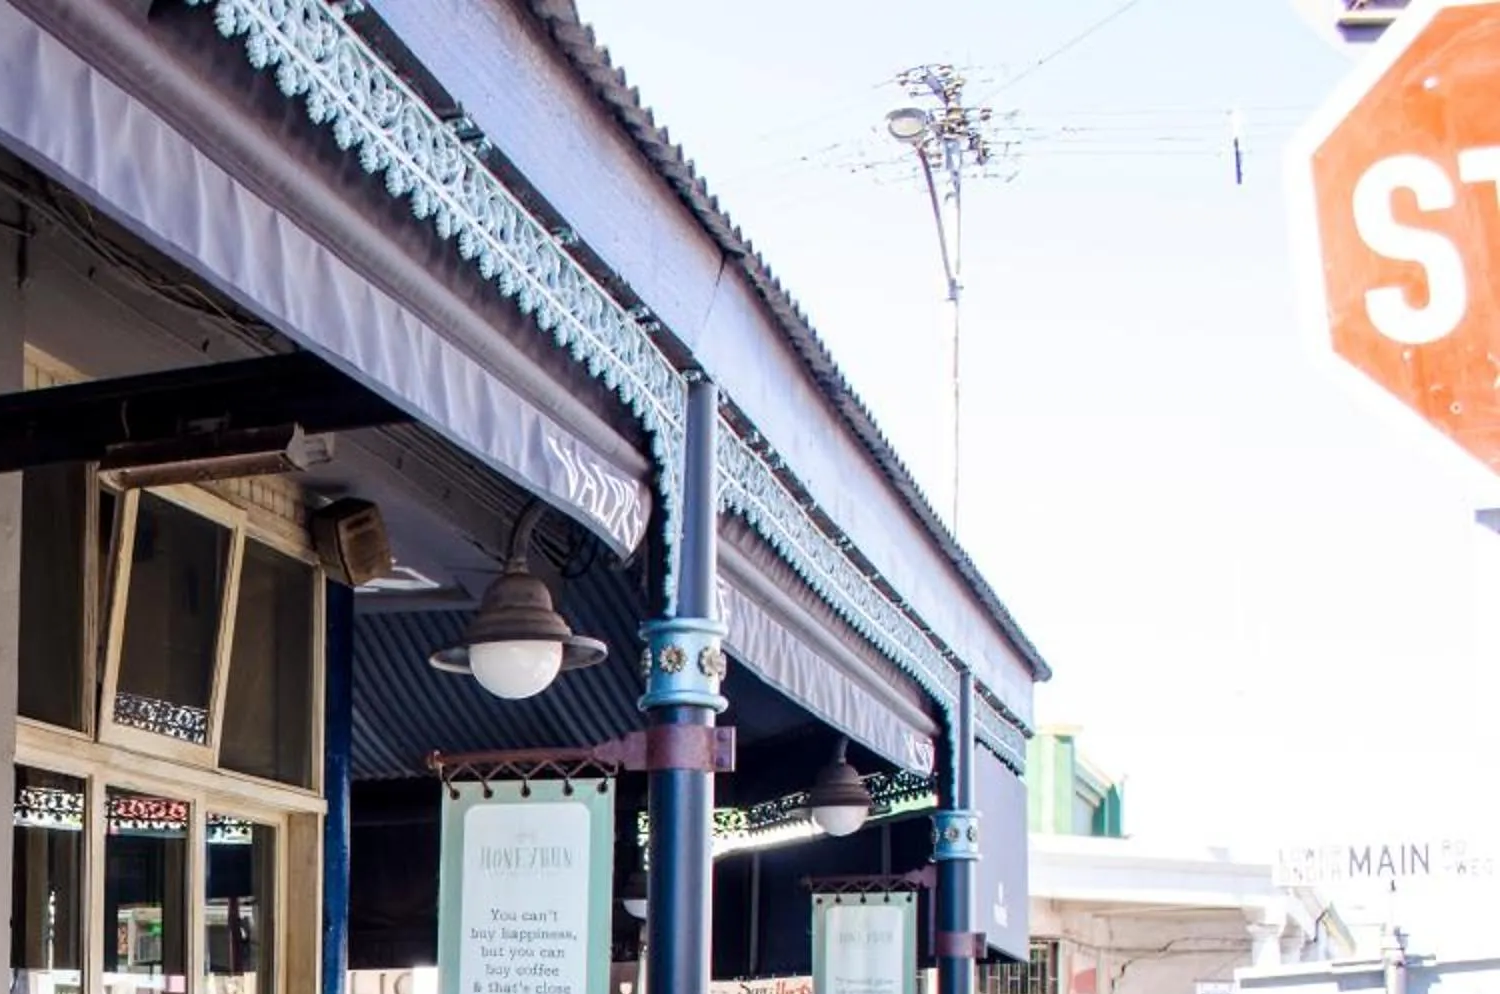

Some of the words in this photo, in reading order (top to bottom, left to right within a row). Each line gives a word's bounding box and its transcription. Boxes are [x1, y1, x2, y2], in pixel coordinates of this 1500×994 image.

[1347, 843, 1430, 879] MAIN
[491, 908, 517, 921] You
[521, 910, 557, 922] can't
[470, 928, 496, 942] buy
[481, 946, 504, 957] but
[509, 947, 534, 961] you
[539, 948, 564, 958] can
[485, 964, 510, 978] buy
[516, 964, 560, 977] coffee
[535, 981, 572, 994] close
